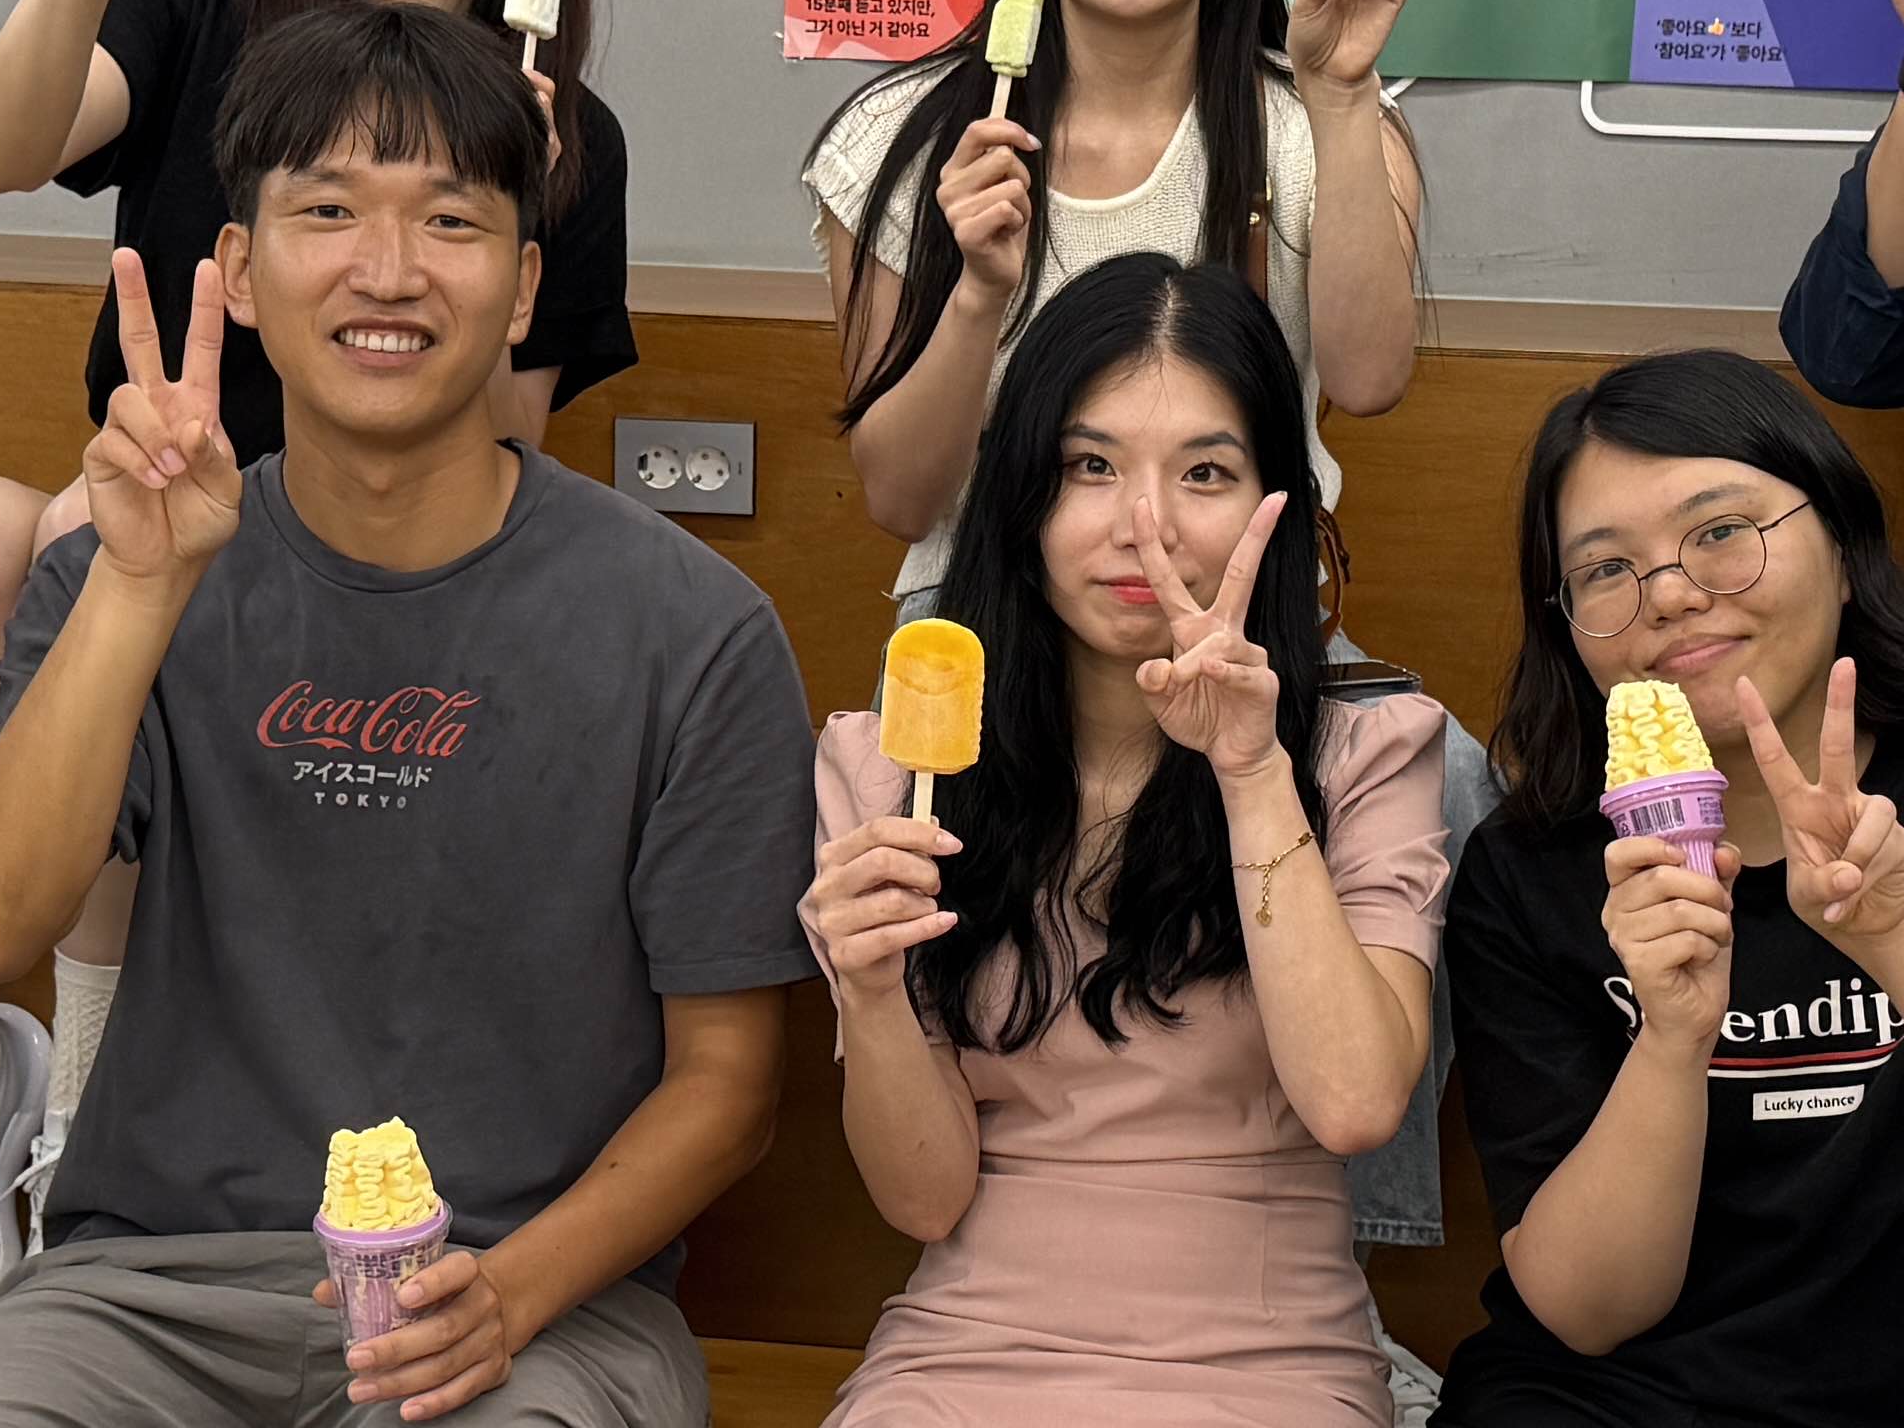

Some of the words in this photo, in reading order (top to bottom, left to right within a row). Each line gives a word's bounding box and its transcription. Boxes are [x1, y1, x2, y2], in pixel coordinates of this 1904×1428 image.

[805, 19, 833, 35] 그거
[837, 20, 865, 36] 아닌
[870, 22, 882, 38] 거
[293, 761, 432, 788] アイスコールド
[315, 792, 406, 809] TOKYO
[1764, 1096, 1804, 1115] Lucky
[1806, 1094, 1855, 1110] chance
